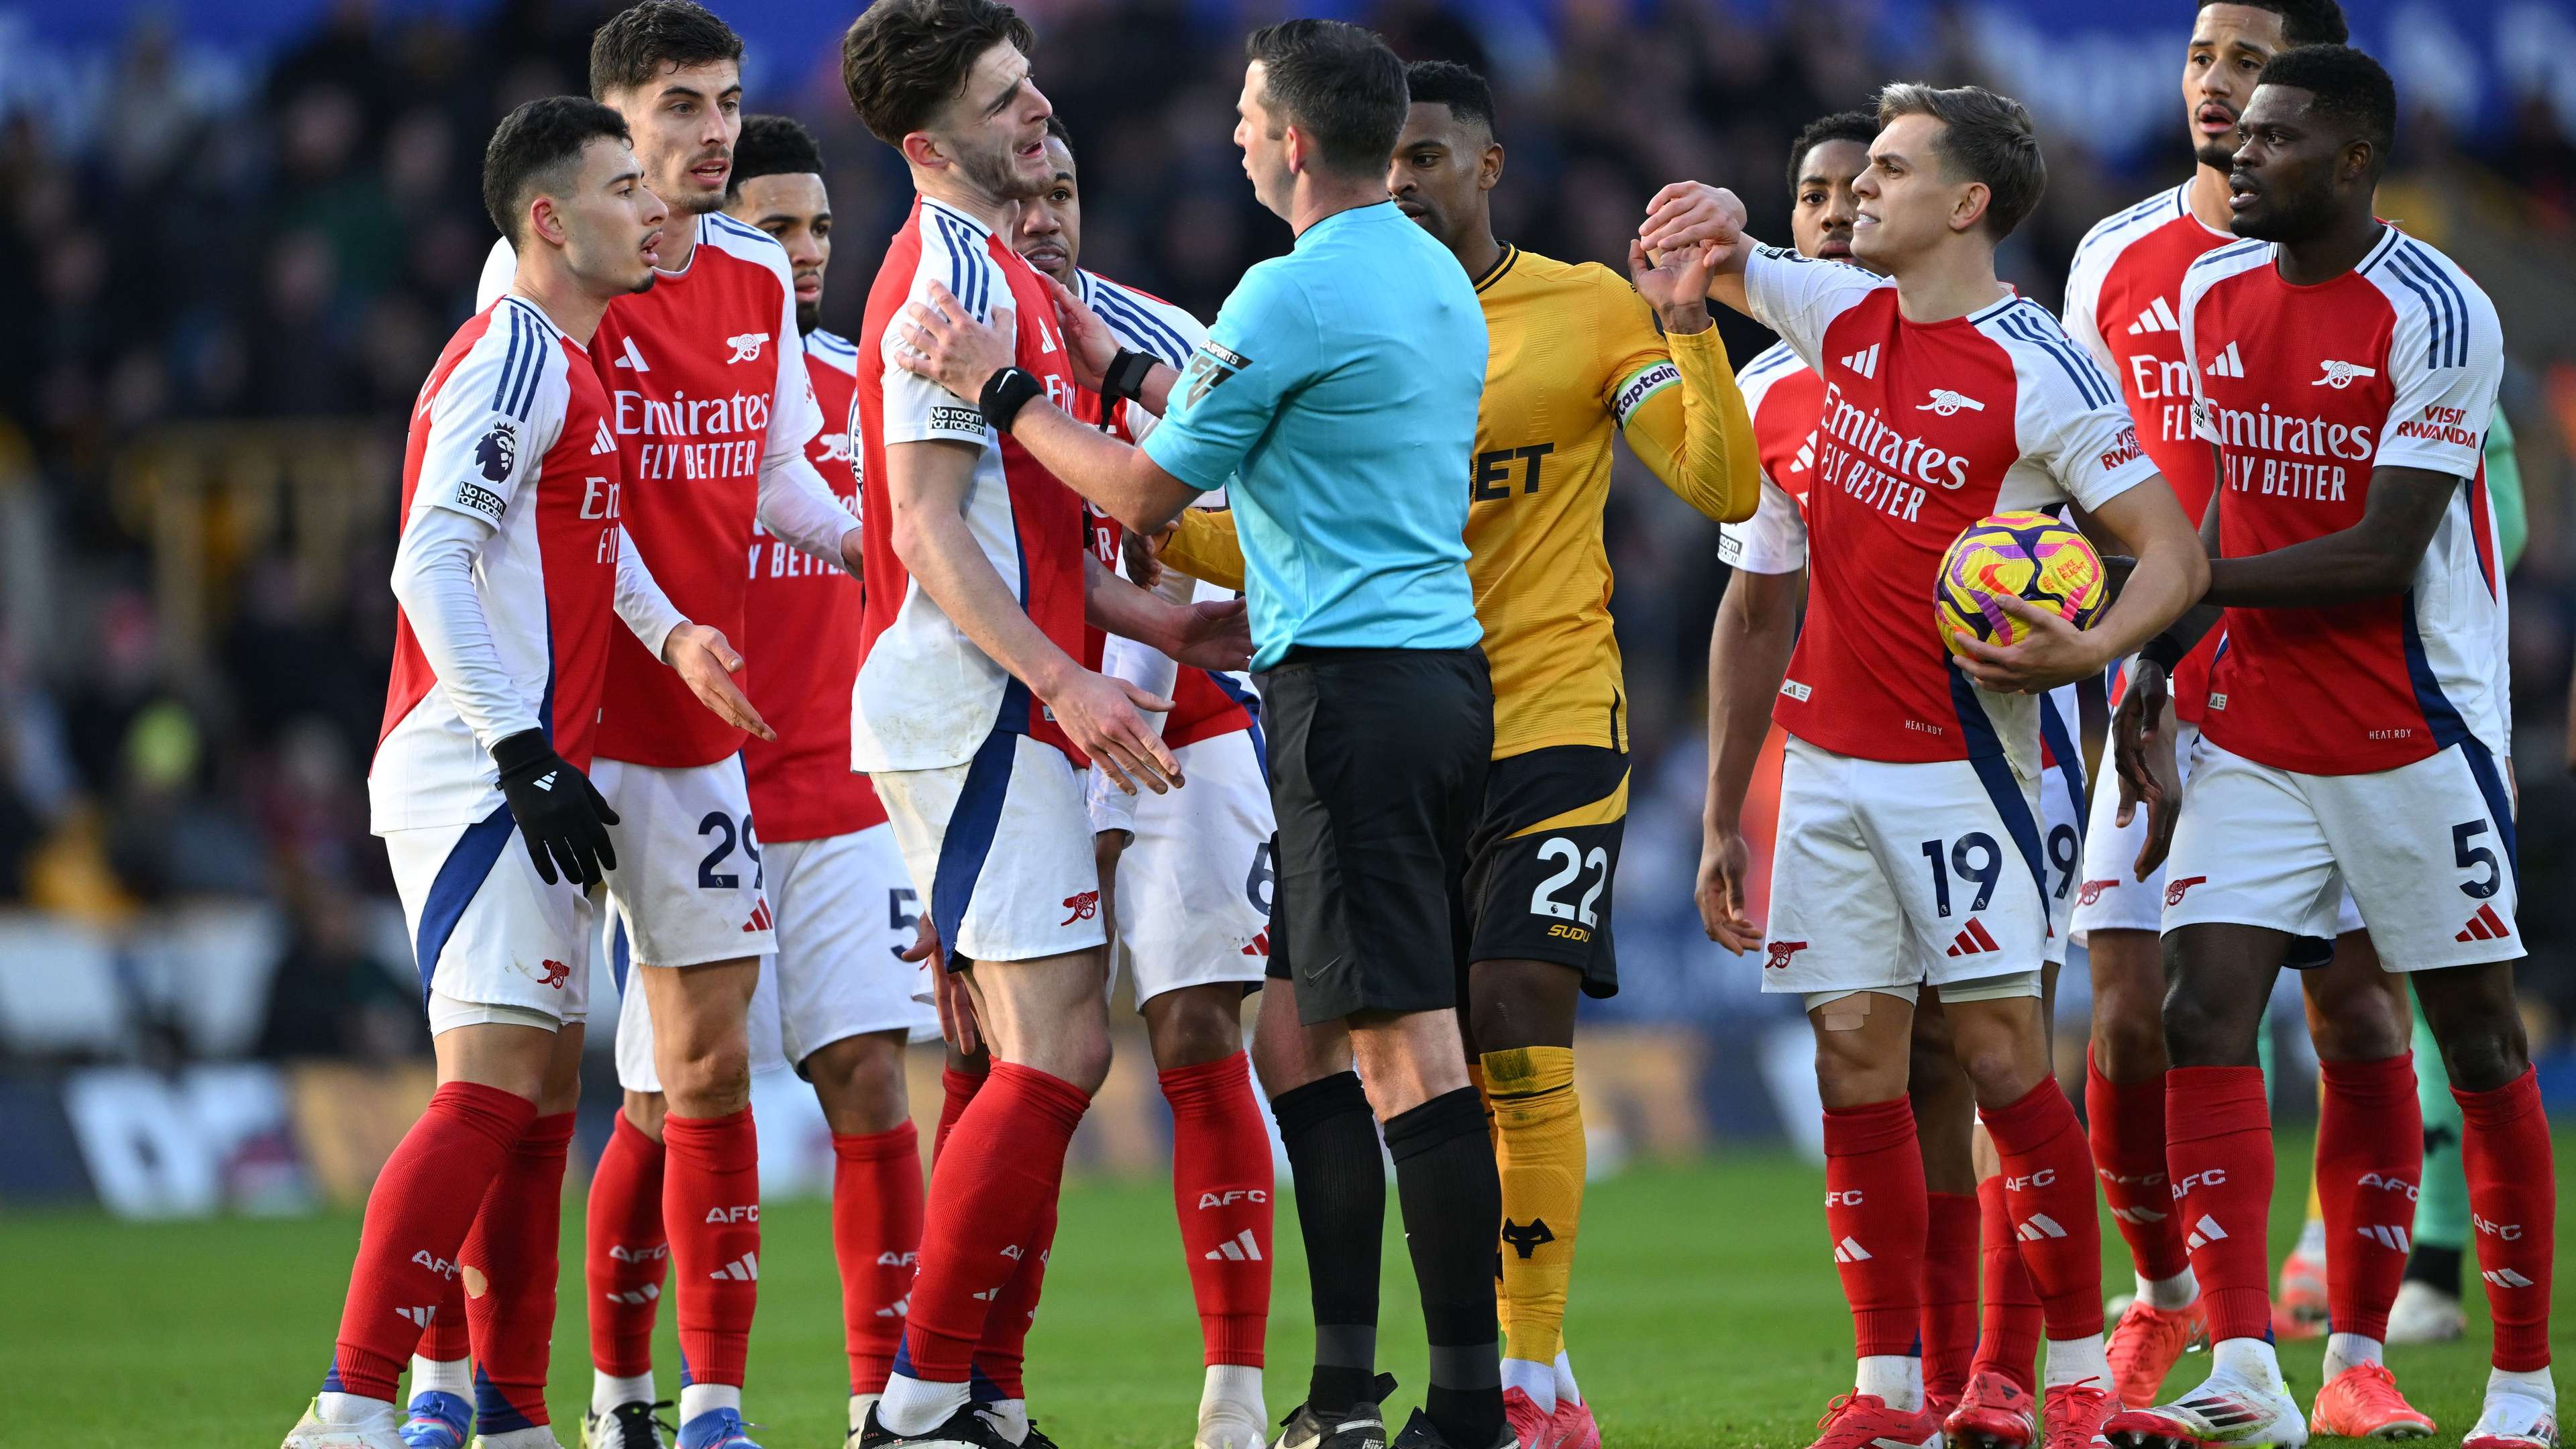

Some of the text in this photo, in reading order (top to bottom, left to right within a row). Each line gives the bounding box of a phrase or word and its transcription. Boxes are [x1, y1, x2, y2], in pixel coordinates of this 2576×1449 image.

[614, 389, 769, 436] Emirates
[930, 407, 983, 424] No room
[930, 417, 986, 436] for racism
[2425, 405, 2467, 425] VISIT
[1821, 381, 1970, 490] Emirates
[2397, 421, 2476, 449] RWANDA
[640, 440, 756, 480] FLY BETTER
[1822, 442, 1926, 523] FLY BETTER
[2225, 453, 2346, 501] FLY BETTER
[457, 492, 502, 523] for racism
[459, 482, 504, 513] No room
[2057, 559, 2076, 574] NIKE
[2061, 561, 2085, 581] FLIGHT
[1905, 719, 1943, 736] HEAT.RDY
[2369, 729, 2412, 740] HEAT.RDY
[698, 811, 763, 890] 29
[2452, 818, 2501, 899] 5
[1246, 843, 1274, 916] 6
[1530, 837, 1607, 930] 22
[1922, 832, 2002, 918] 19
[1547, 924, 1592, 943] SUDU
[2006, 1169, 2055, 1192] AFC
[2172, 1169, 2226, 1201] AFC
[2357, 1173, 2419, 1202] AFC
[706, 1205, 759, 1223] AFC
[1199, 1189, 1267, 1210] AFC
[2473, 1213, 2522, 1241] AFC
[412, 1249, 456, 1281] AFC
